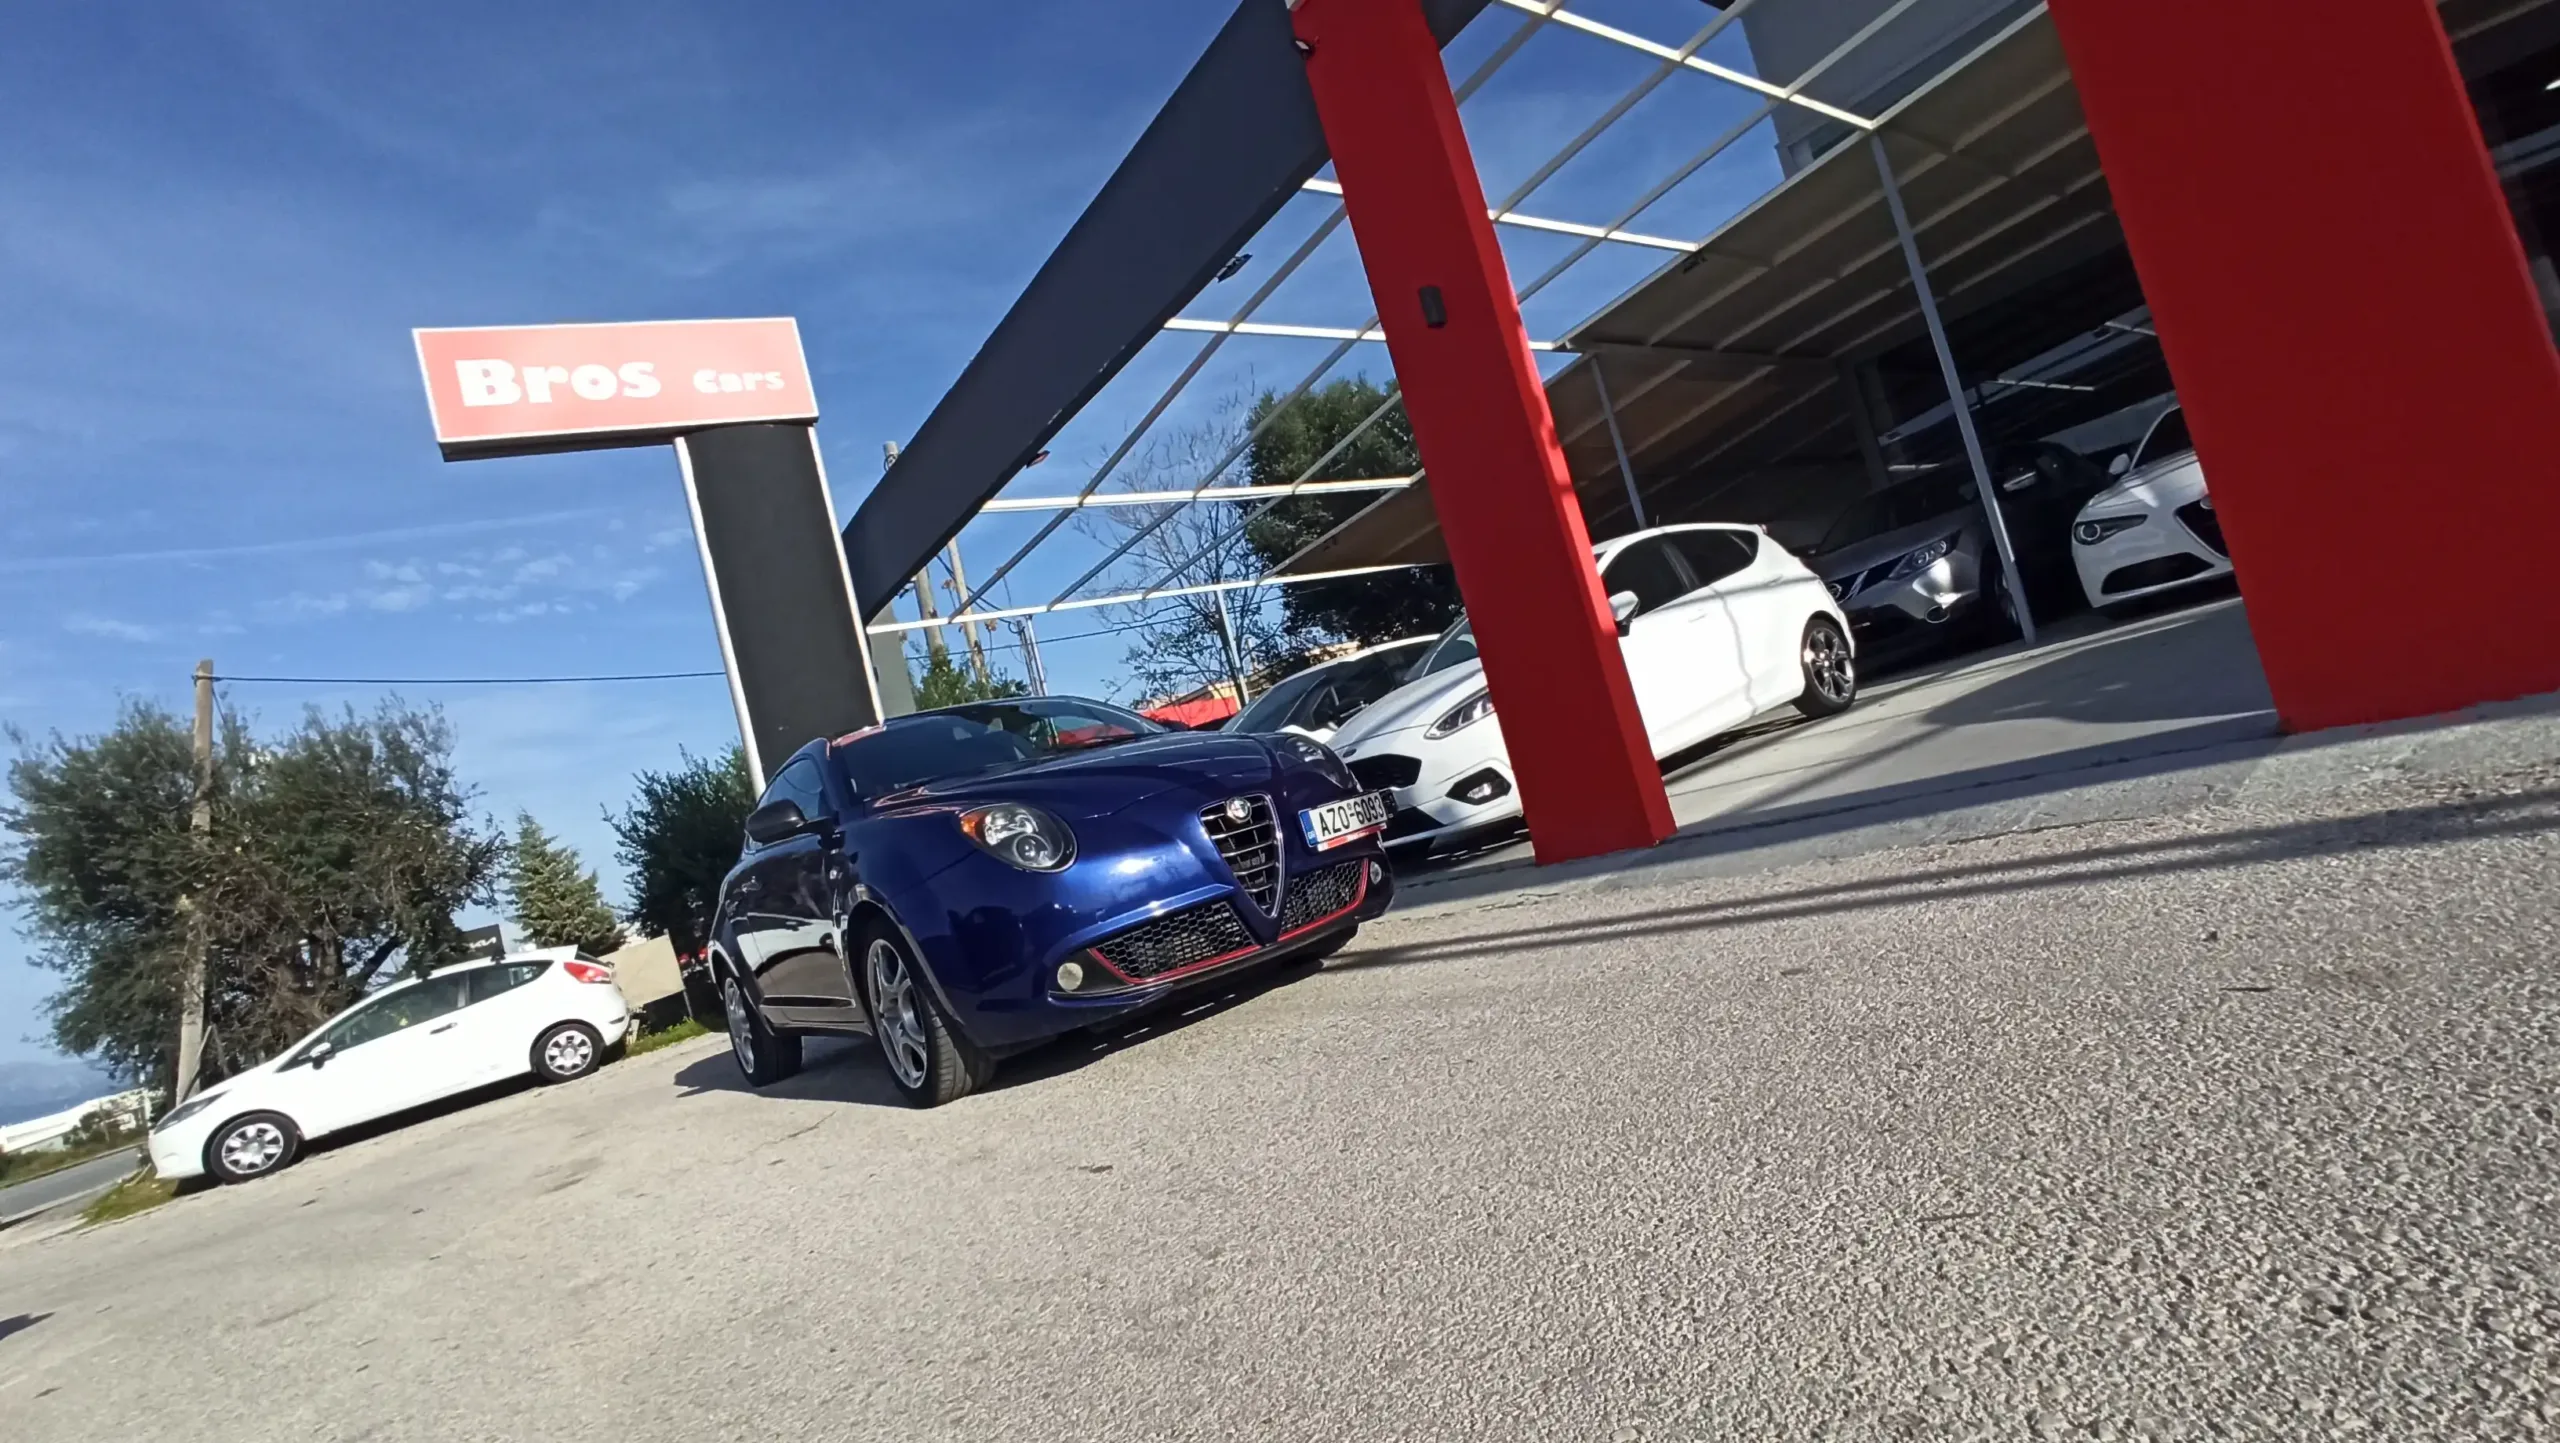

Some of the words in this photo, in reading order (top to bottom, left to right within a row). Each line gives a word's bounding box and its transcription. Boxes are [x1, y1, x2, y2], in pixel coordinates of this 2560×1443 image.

[454, 359, 662, 407] Bros
[692, 369, 786, 394] Cars
[1318, 795, 1385, 837] AZO-6093
